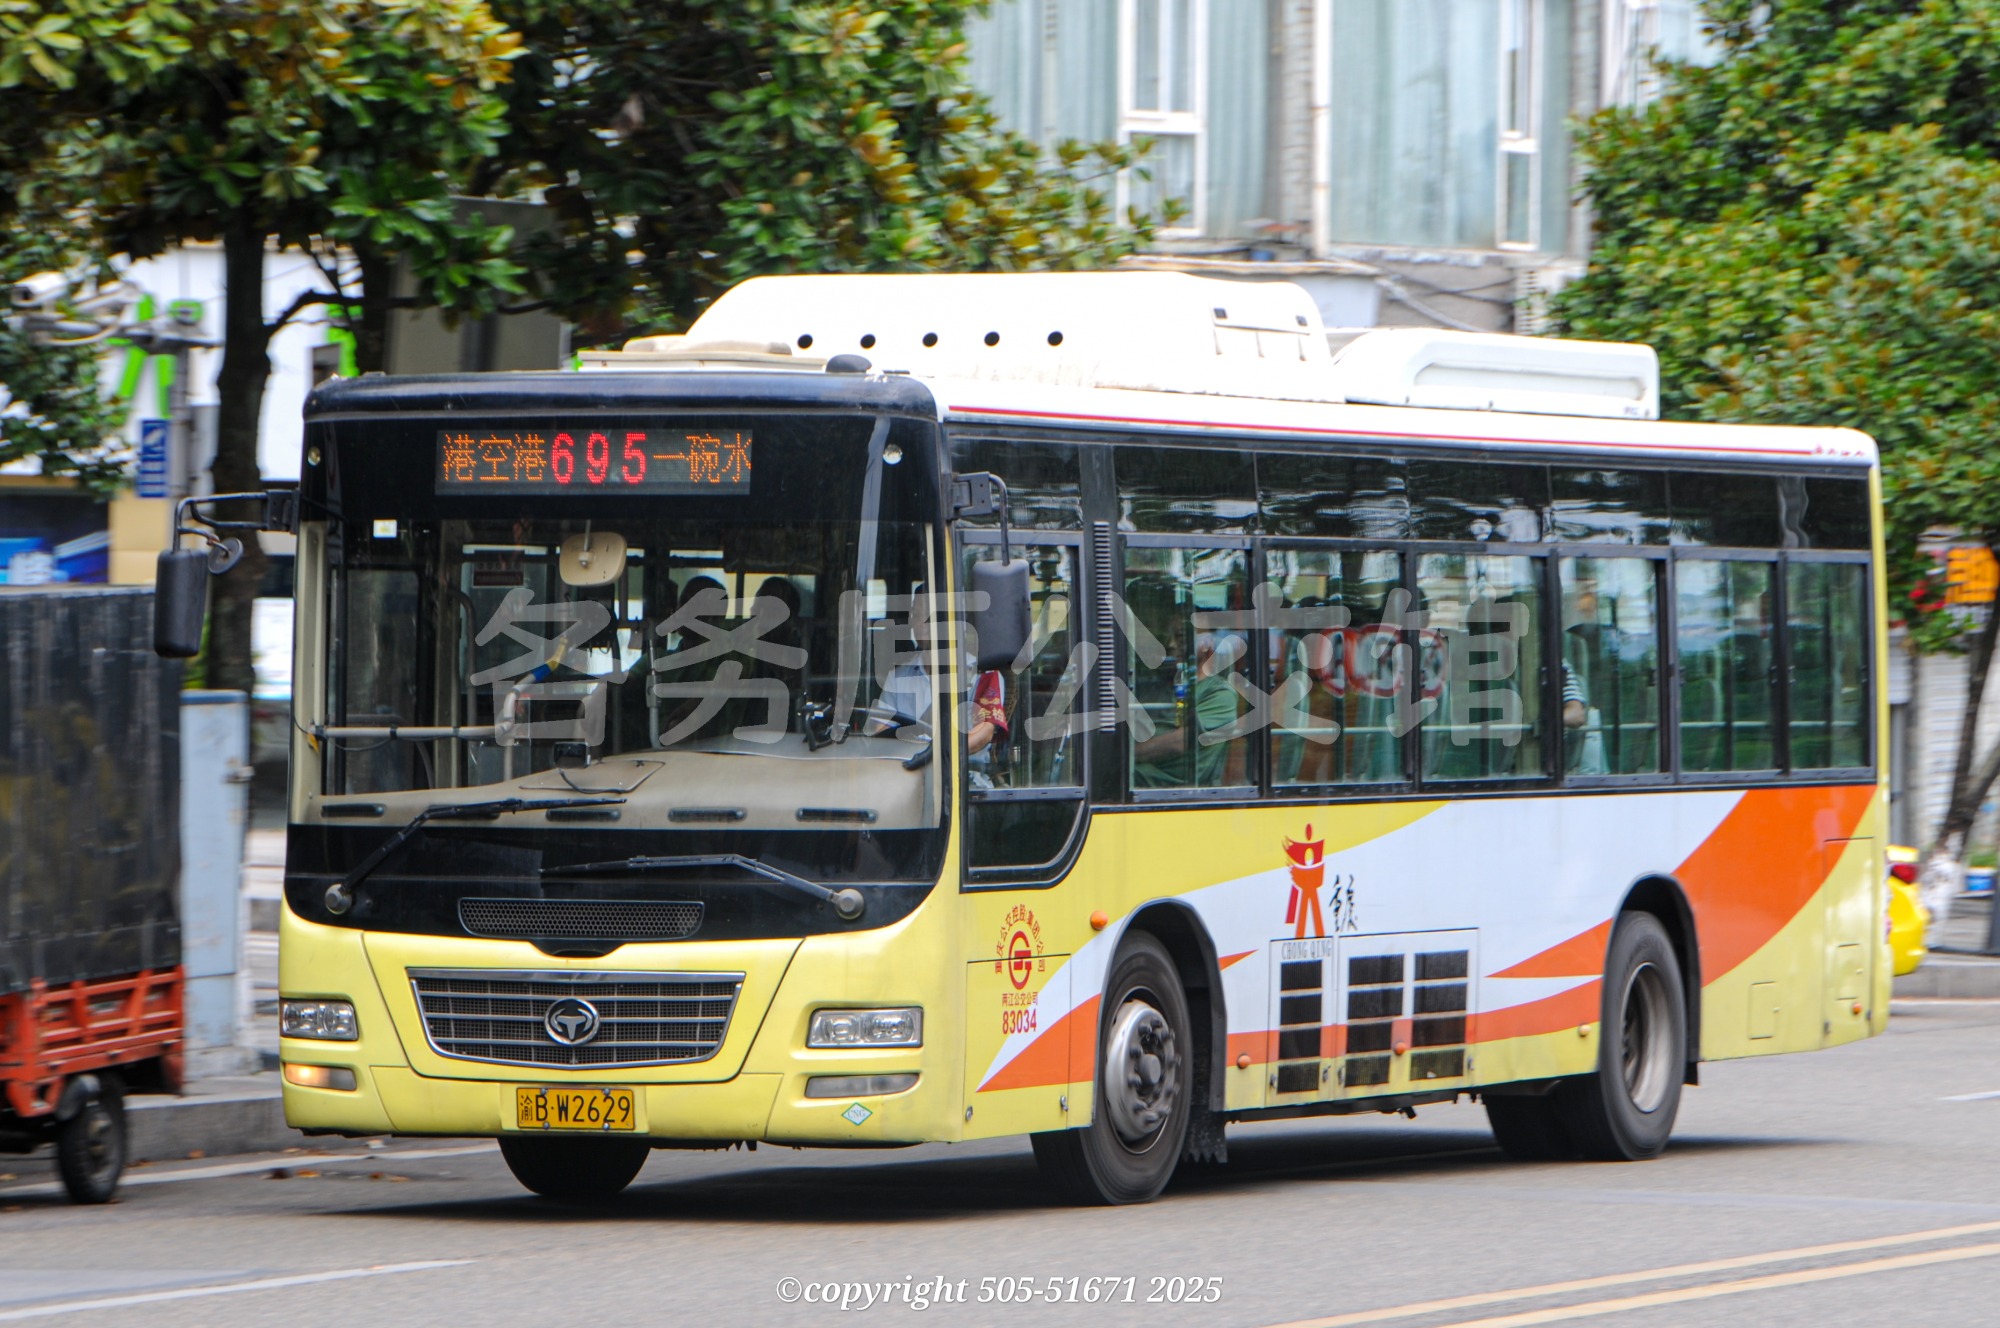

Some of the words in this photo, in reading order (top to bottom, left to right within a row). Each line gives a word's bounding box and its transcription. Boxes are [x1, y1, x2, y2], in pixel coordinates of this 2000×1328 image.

[442, 433, 548, 482] 港空港
[551, 432, 648, 485] 695
[1281, 942, 1307, 960] CHONG
[1310, 940, 1332, 959] QING
[1002, 991, 1039, 1006] 两江公交公司
[1002, 1009, 1037, 1034] 83034
